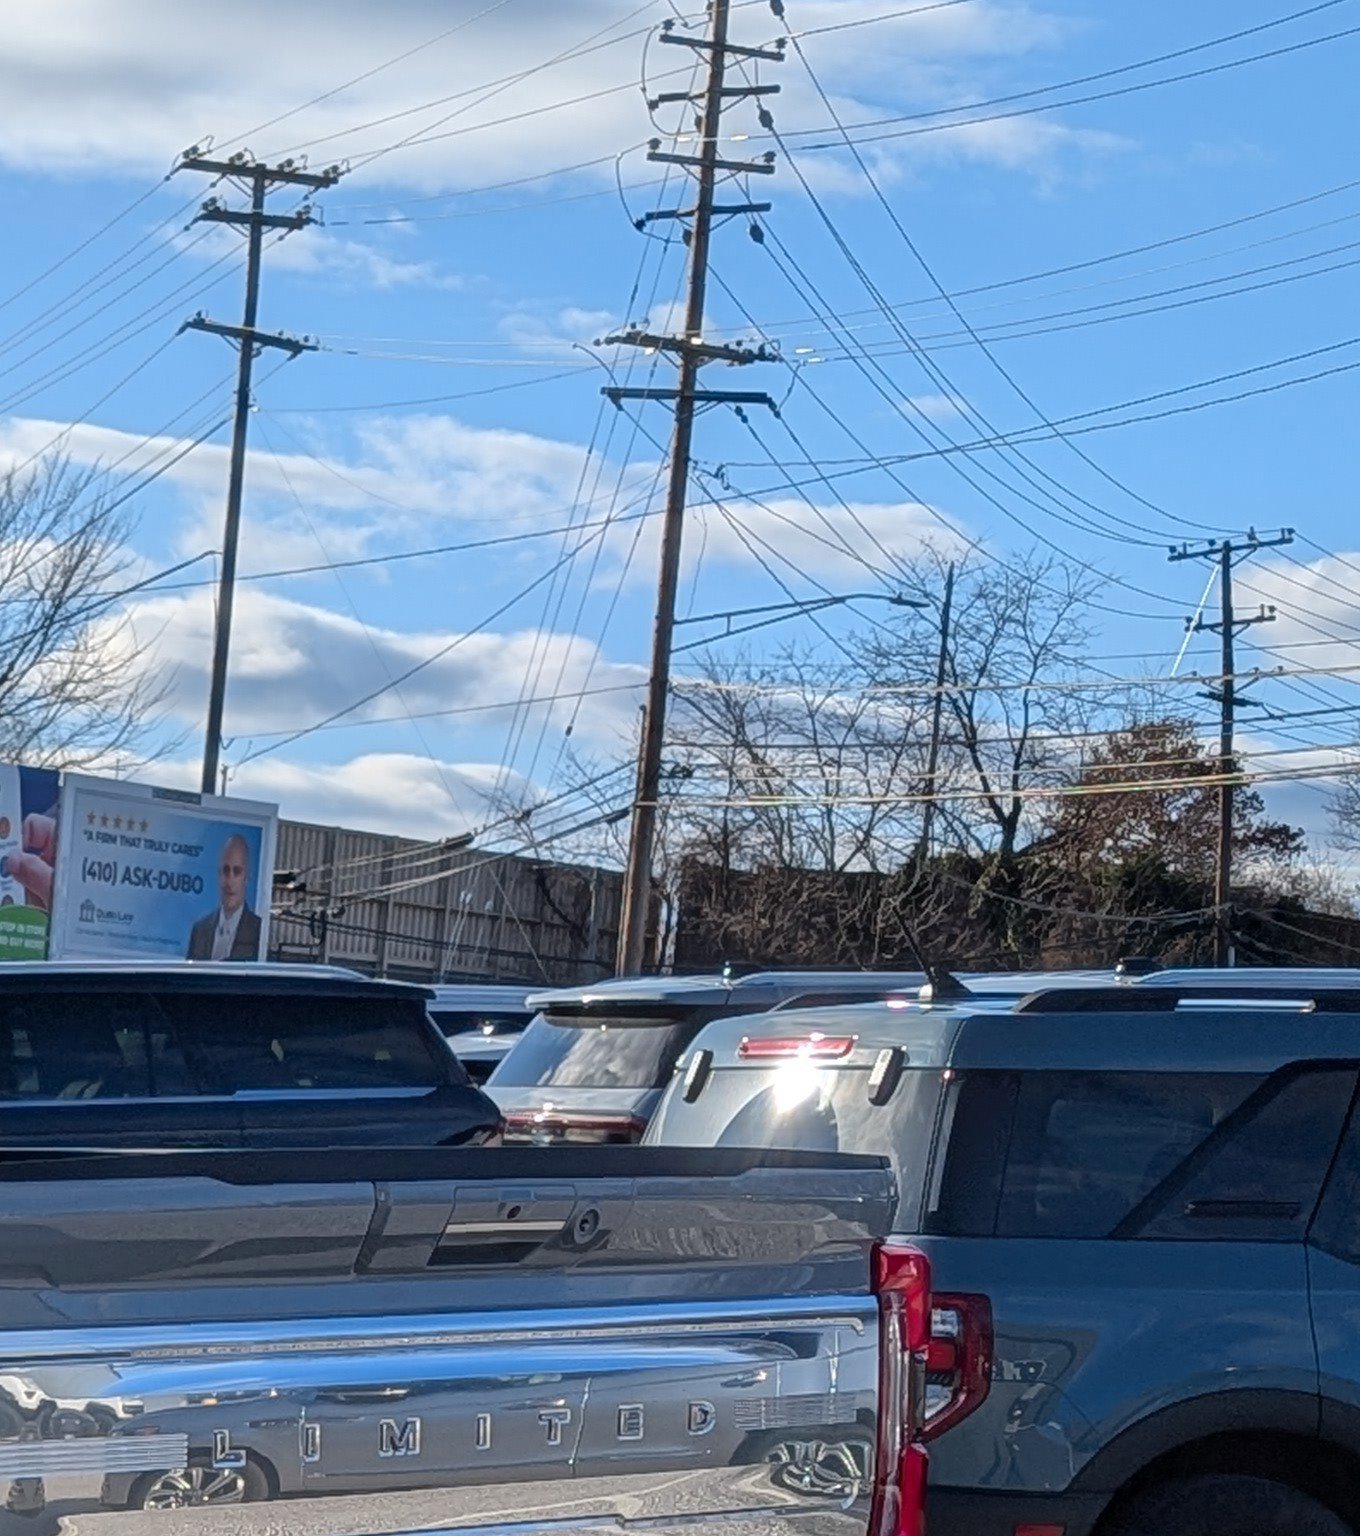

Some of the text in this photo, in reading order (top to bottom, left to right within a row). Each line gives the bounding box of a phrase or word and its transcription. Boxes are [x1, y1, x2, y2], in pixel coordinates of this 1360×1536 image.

[120, 835, 142, 849] THAT
[144, 838, 170, 853] TRULY
[82, 856, 205, 895] (410) ASK-DUBO
[211, 1400, 717, 1469] LIMITED
